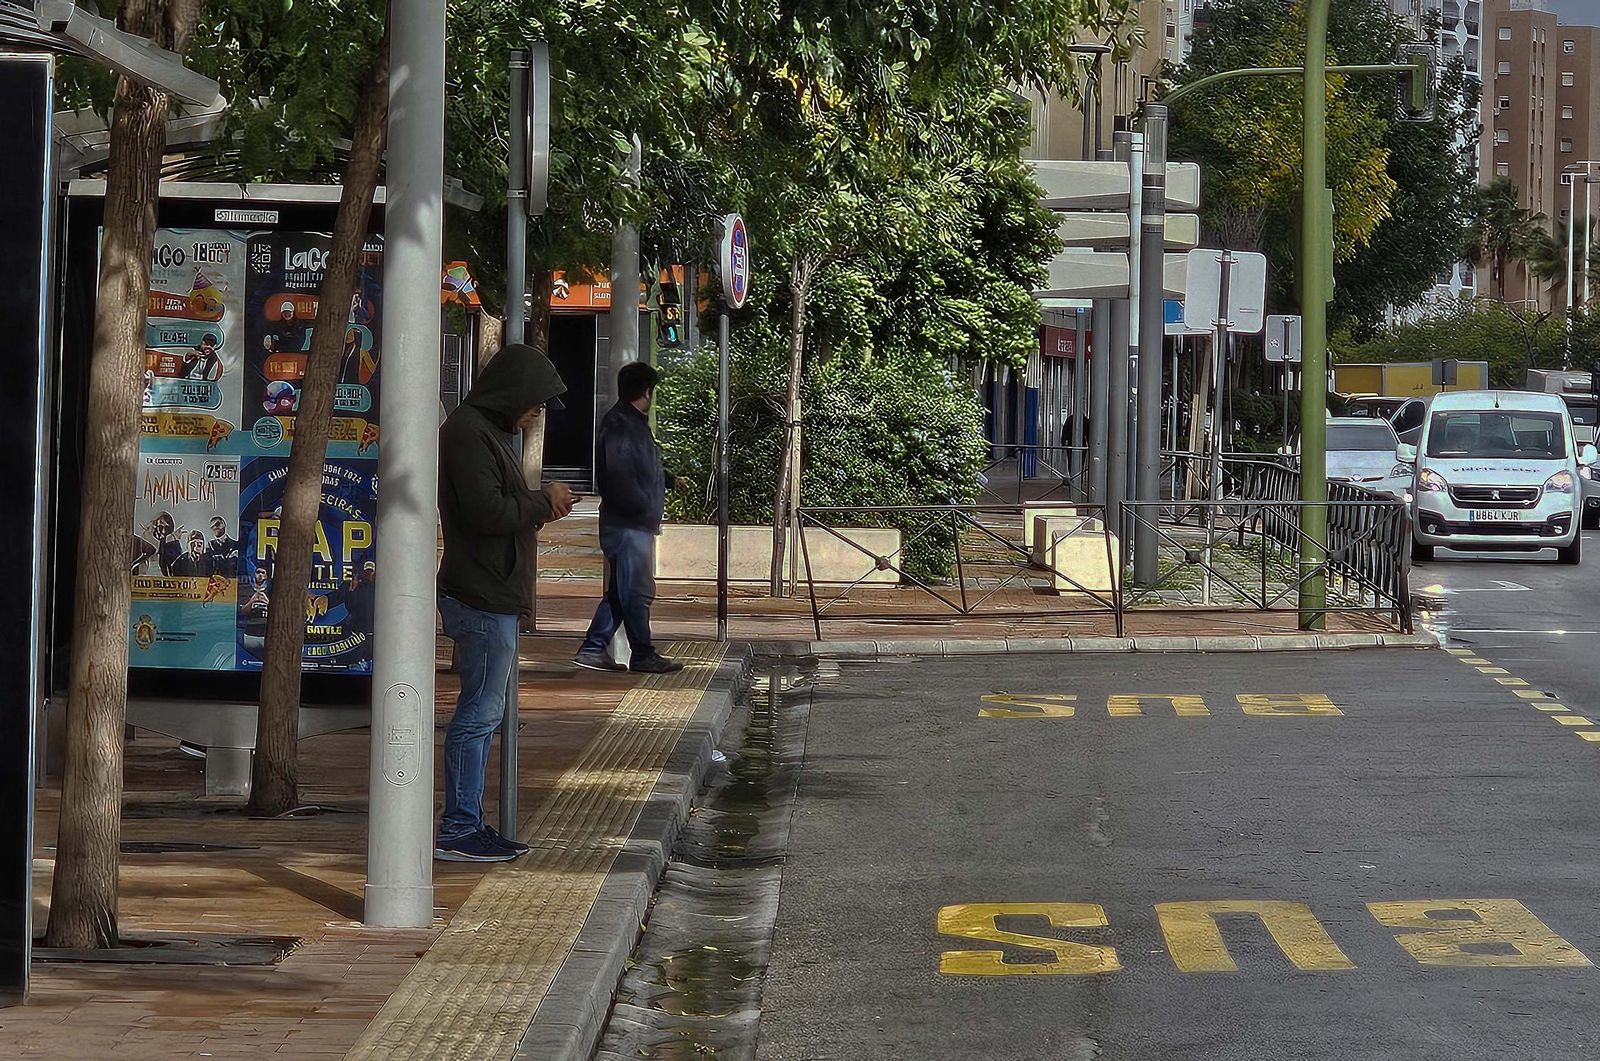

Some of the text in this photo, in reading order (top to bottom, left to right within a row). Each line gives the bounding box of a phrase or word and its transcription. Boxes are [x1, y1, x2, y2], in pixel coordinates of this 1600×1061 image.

[137, 469, 217, 509] AMANERA
[320, 493, 362, 520] ECIRAS
[257, 518, 372, 563] RAP
[978, 693, 1345, 717] BUS
[937, 898, 1594, 977] BUS
